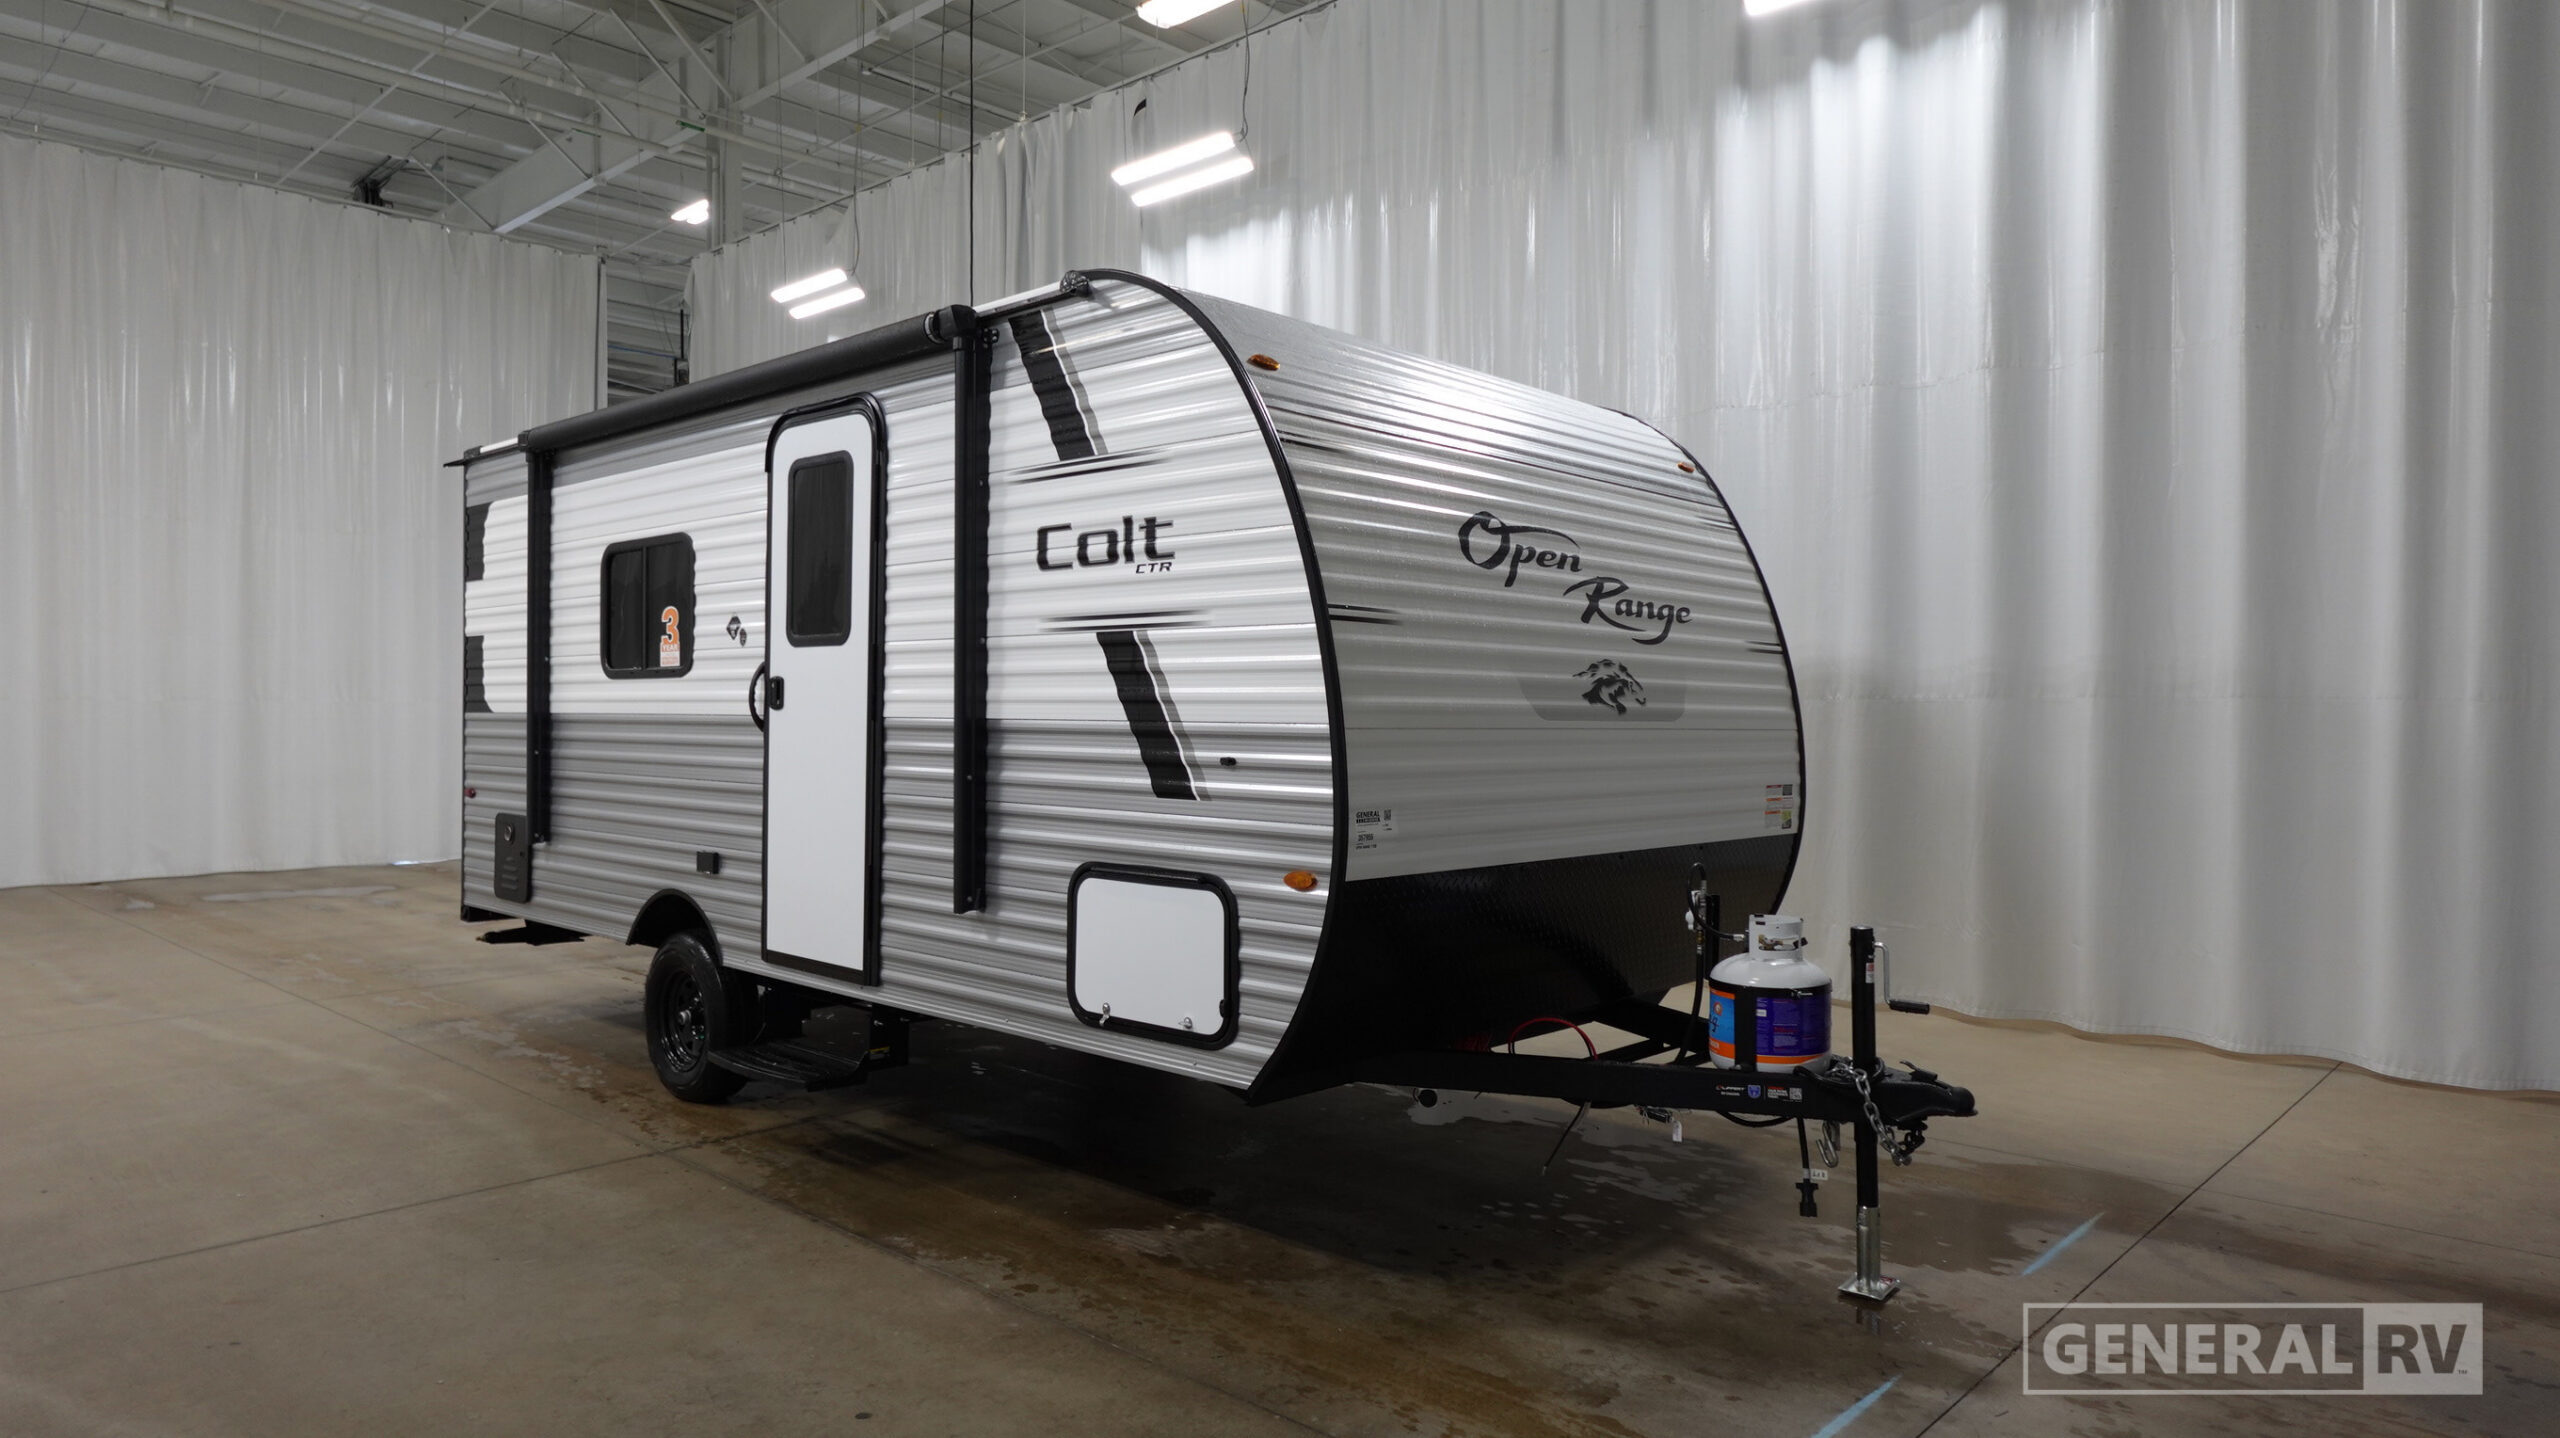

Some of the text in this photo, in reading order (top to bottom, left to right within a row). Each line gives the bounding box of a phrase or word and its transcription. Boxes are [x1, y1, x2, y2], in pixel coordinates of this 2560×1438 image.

[1036, 515, 1176, 572] Colt
[1135, 561, 1173, 574] CTR
[1458, 511, 1583, 588] Open
[661, 605, 680, 645] 3
[1563, 576, 1693, 646] Range
